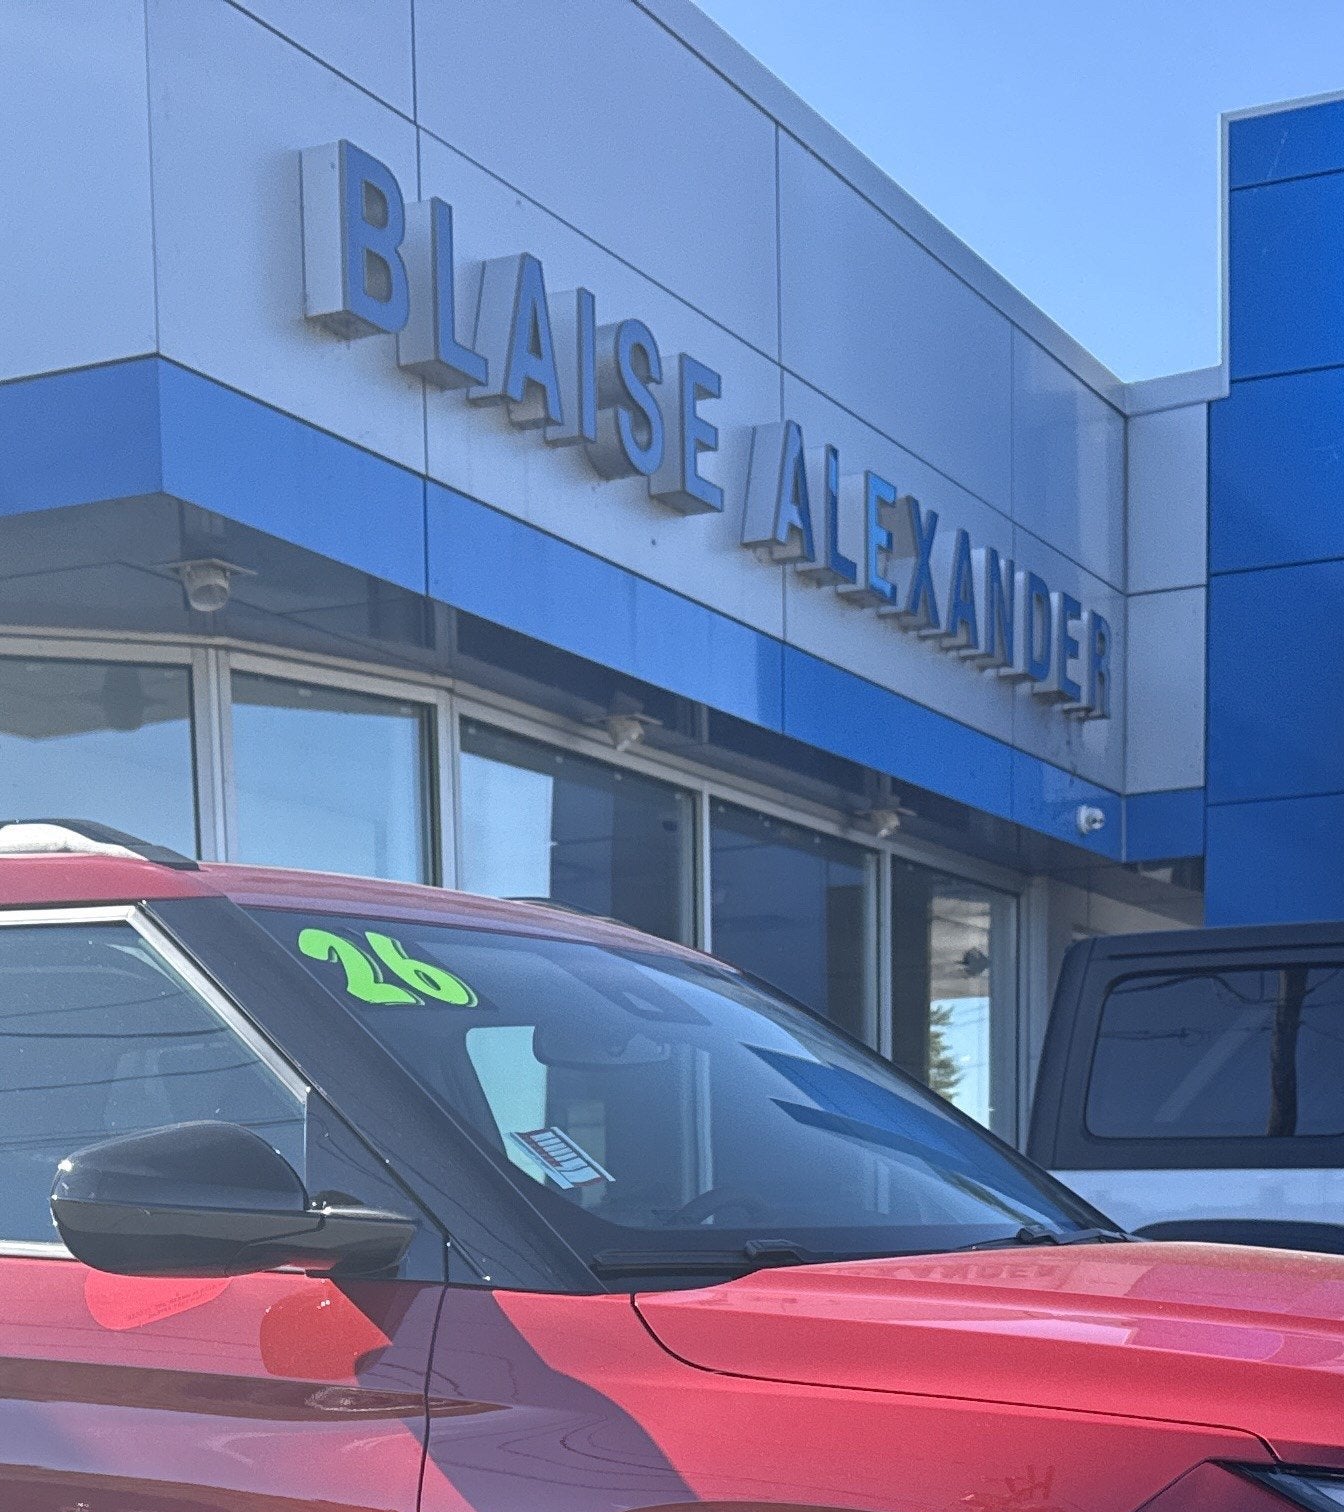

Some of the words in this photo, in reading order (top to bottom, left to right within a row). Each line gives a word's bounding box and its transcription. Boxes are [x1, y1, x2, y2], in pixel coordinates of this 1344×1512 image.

[304, 139, 724, 515] BLAISE
[744, 420, 1113, 720] ALEXANDER
[297, 927, 479, 1008] 26
